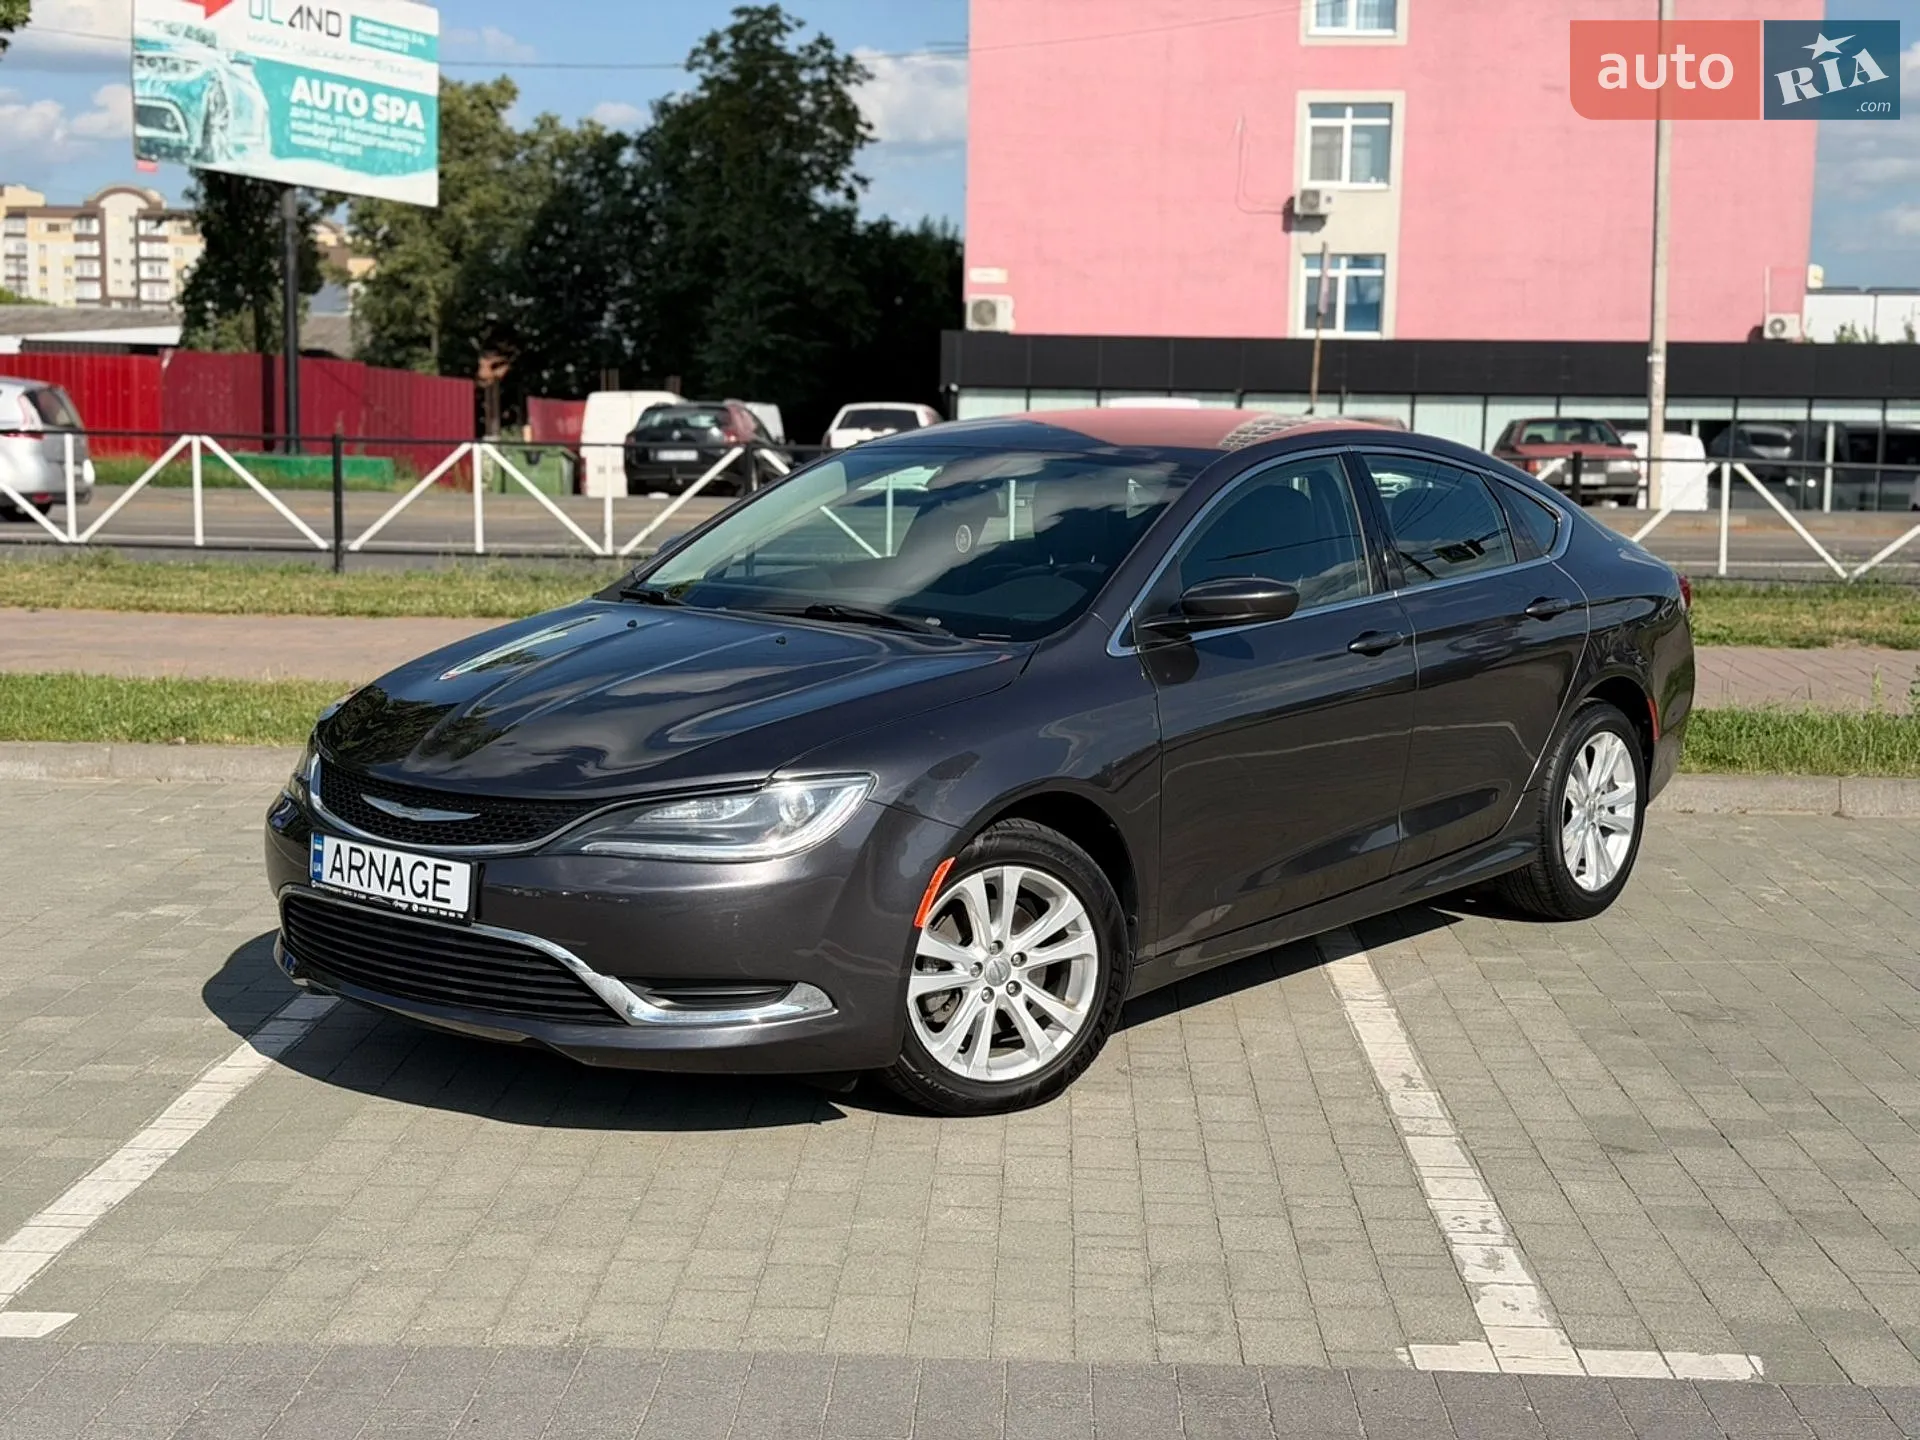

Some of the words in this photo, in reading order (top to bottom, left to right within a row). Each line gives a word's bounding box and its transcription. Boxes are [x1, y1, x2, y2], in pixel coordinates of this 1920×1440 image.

[289, 76, 369, 118] AUTO
[371, 93, 425, 130] SPA
[330, 843, 453, 904] ARNAGE
